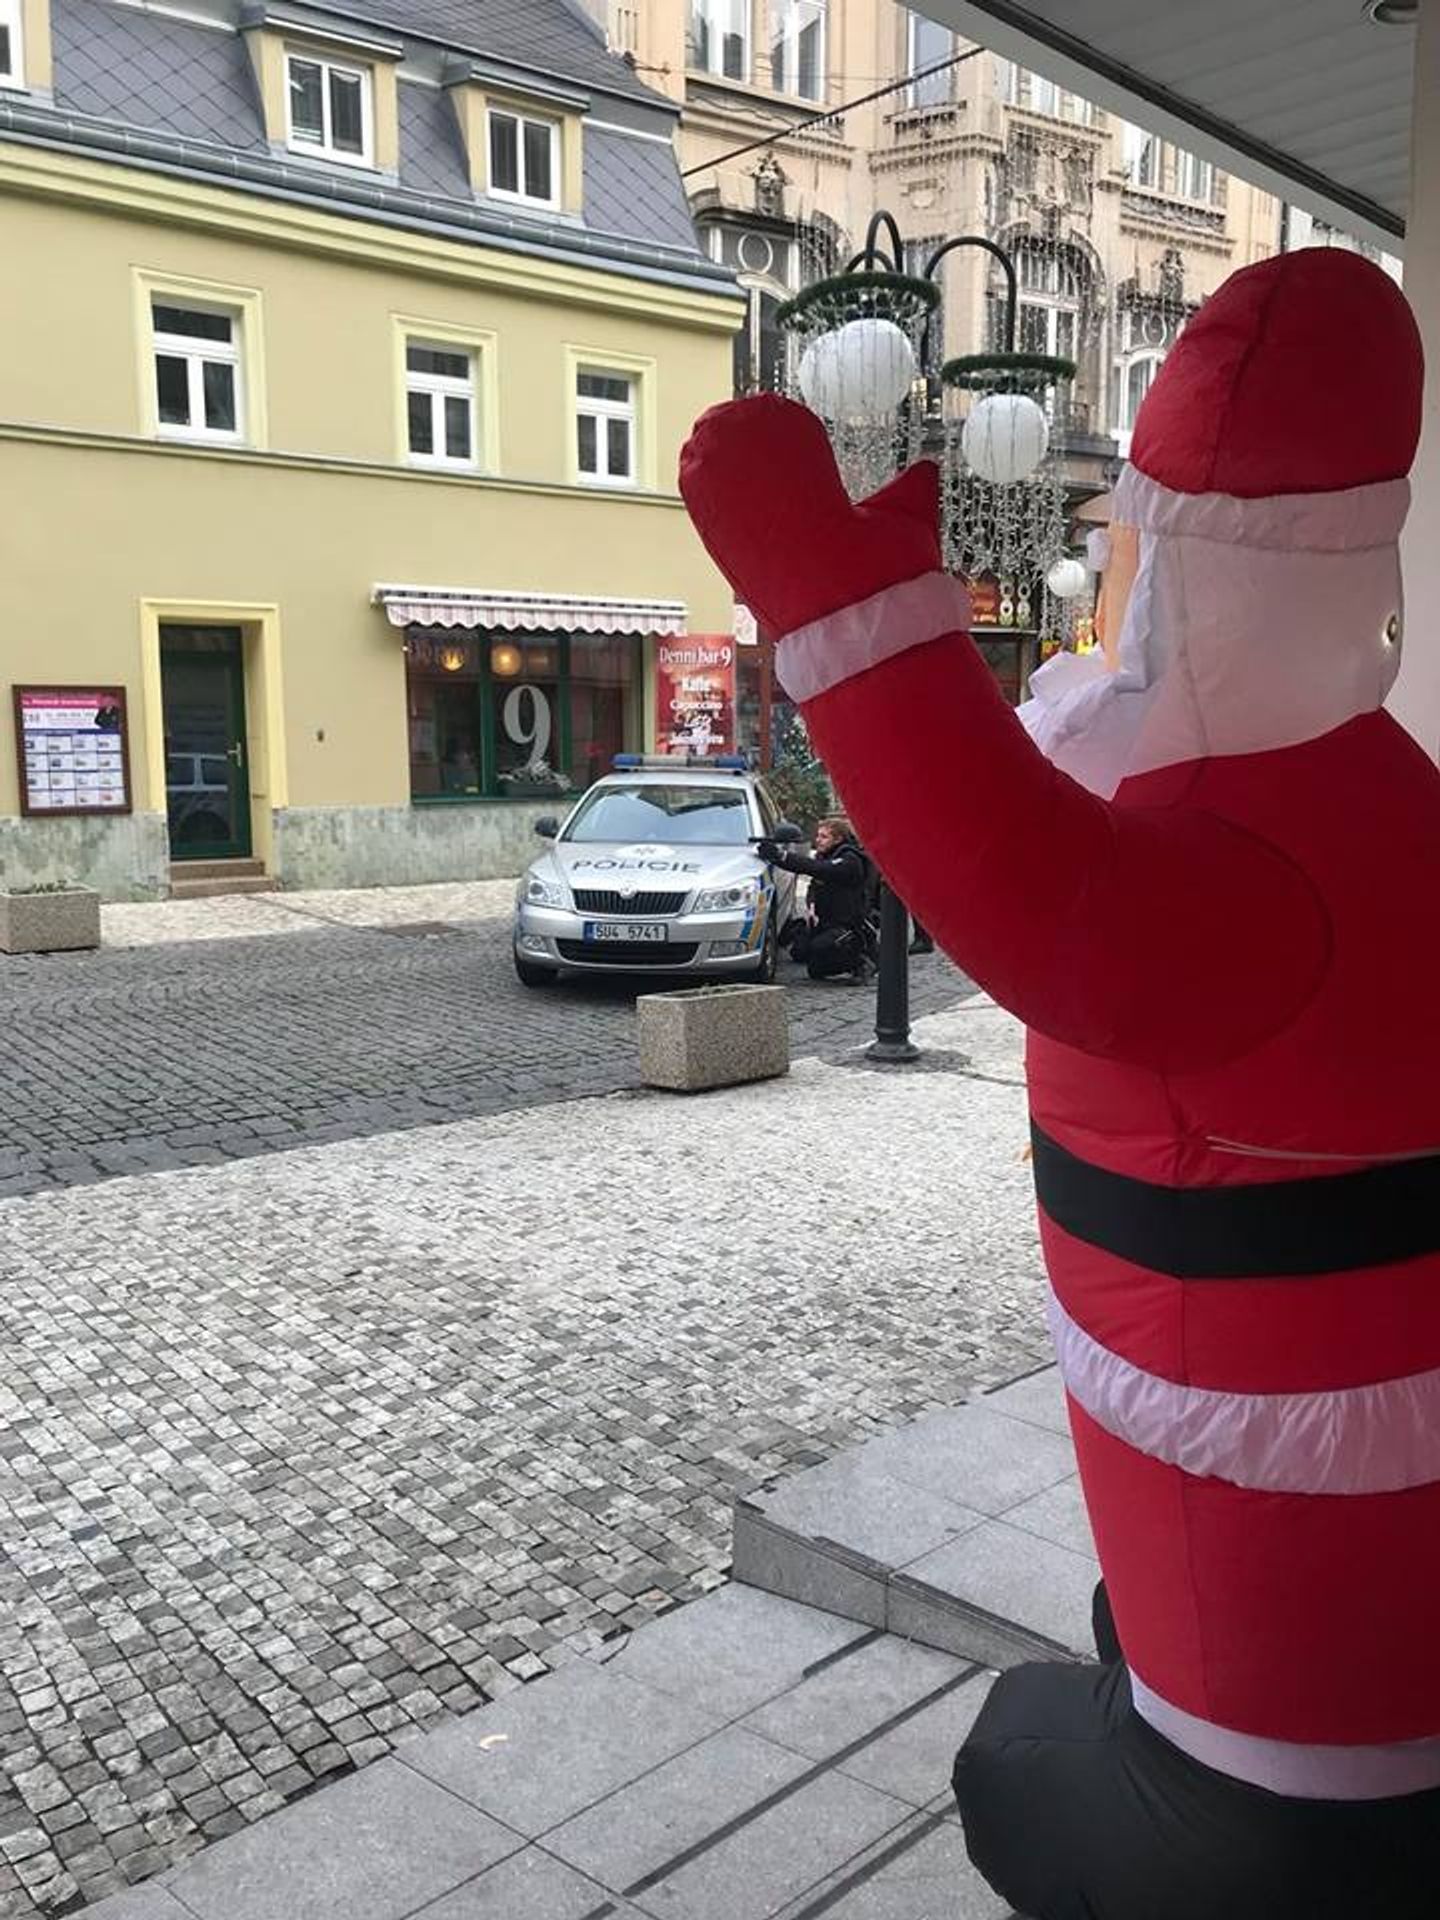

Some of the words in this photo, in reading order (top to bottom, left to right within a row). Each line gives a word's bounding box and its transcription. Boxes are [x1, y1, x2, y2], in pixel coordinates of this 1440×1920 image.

[698, 645, 718, 664] bar
[720, 646, 732, 667] 9
[503, 684, 551, 772] 9
[573, 860, 702, 873] POLICIE
[628, 925, 660, 939] 5741
